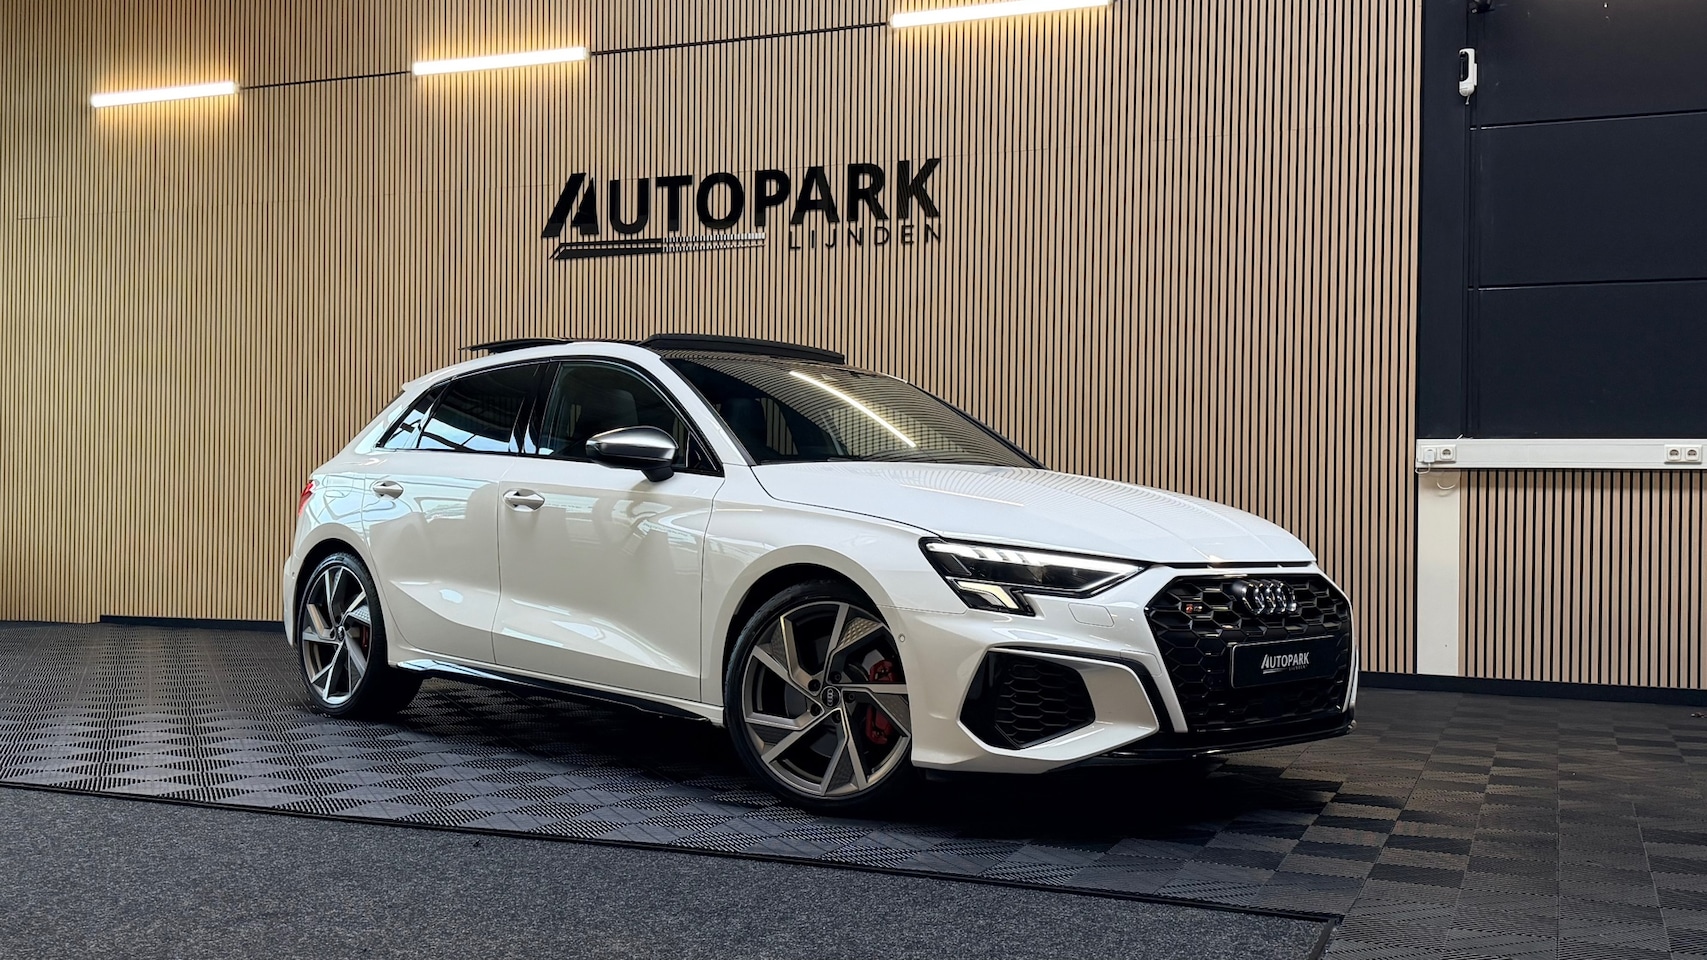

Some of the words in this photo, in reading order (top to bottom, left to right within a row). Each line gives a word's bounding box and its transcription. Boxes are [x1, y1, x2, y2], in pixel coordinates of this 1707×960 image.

[541, 158, 940, 238] AUTOPARK
[789, 223, 941, 251] LIJNDEN
[1261, 652, 1310, 669] AUTOPARK
